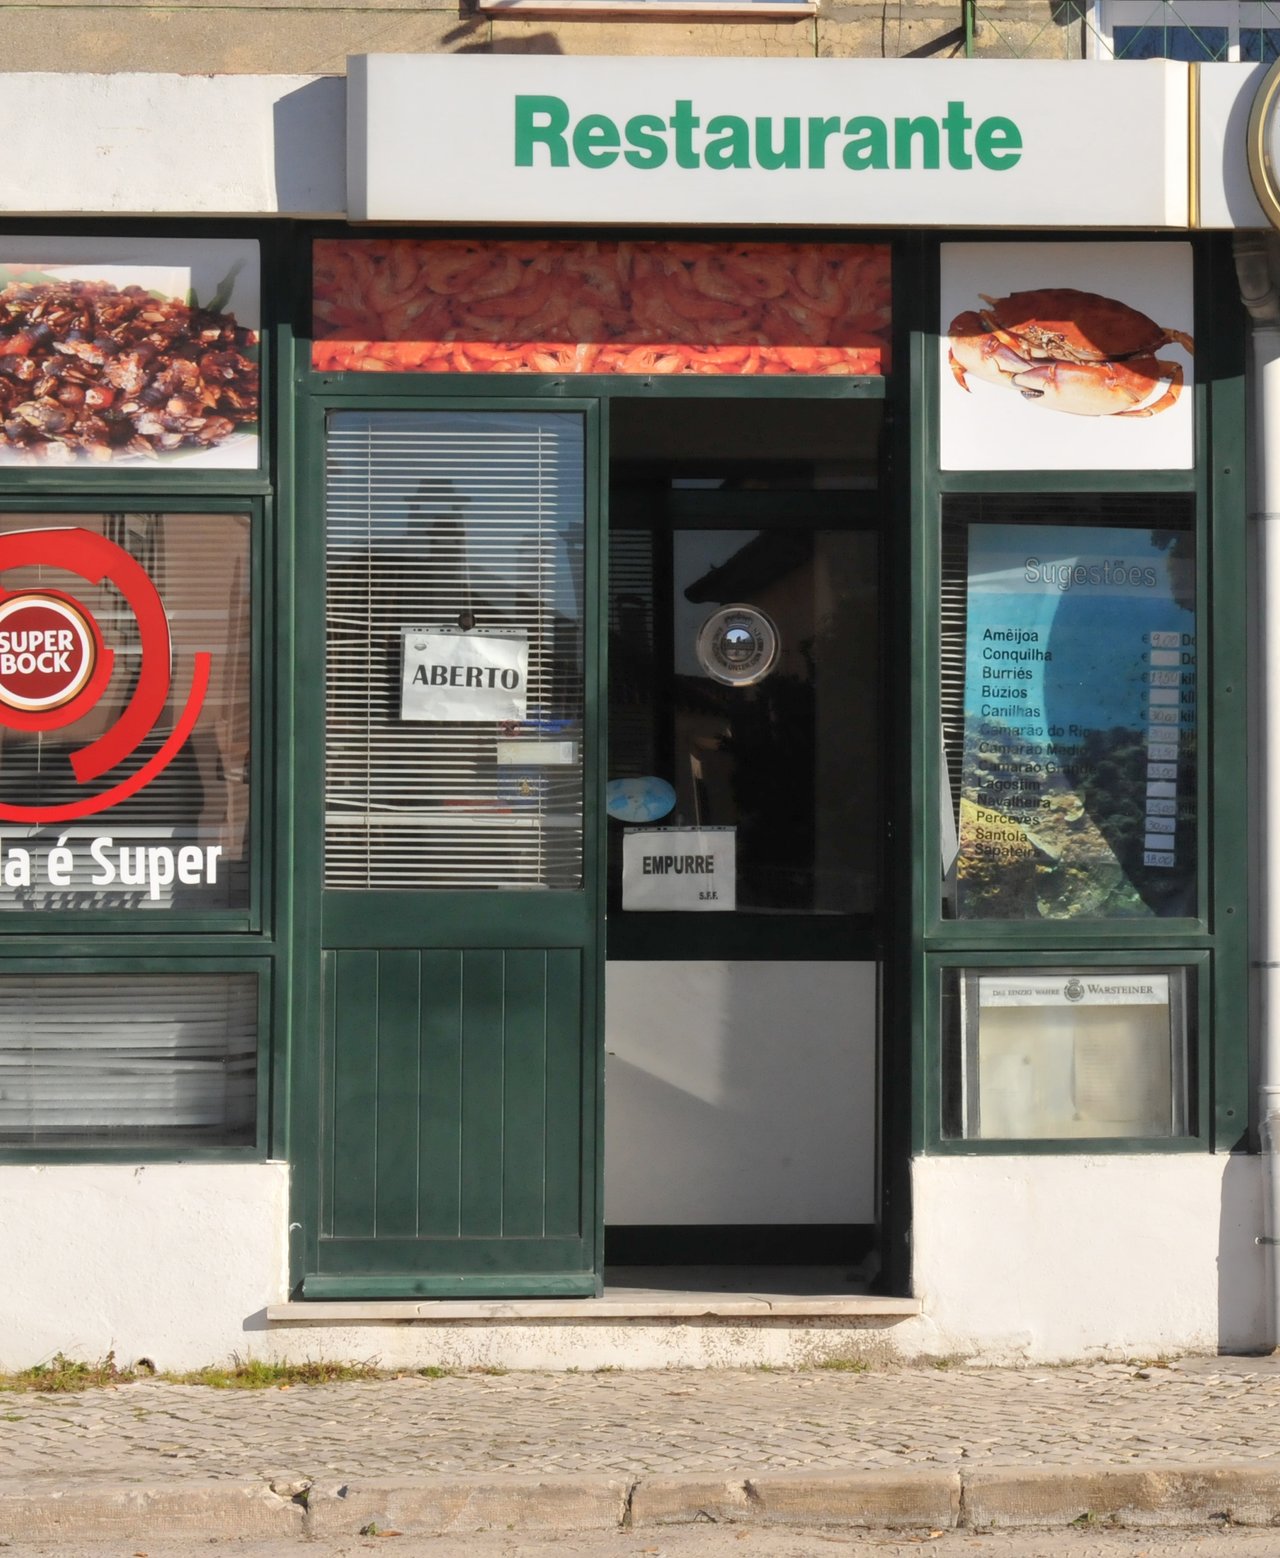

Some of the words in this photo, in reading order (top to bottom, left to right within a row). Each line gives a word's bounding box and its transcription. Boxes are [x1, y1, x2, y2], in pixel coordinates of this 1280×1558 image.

[514, 94, 1023, 171] Restaurante
[1024, 556, 1157, 591] Sugestões
[0, 629, 74, 653] SUPER
[982, 628, 1039, 645] Amêijoa
[0, 652, 72, 675] BOCK
[982, 648, 1053, 665] Conquilha
[412, 664, 520, 689] ABERTO
[982, 666, 1033, 680] Burriés
[981, 684, 1028, 698] Búzios
[981, 703, 1041, 718] Canilhas
[1047, 724, 1065, 737] do
[977, 778, 1041, 792] Lagostim
[975, 828, 1028, 842] Santola
[48, 836, 74, 886] é
[90, 836, 223, 901] Super
[642, 854, 715, 875] EMPURRE
[699, 891, 719, 901] S.F.F.
[1087, 984, 1154, 995] WARSTEINER
